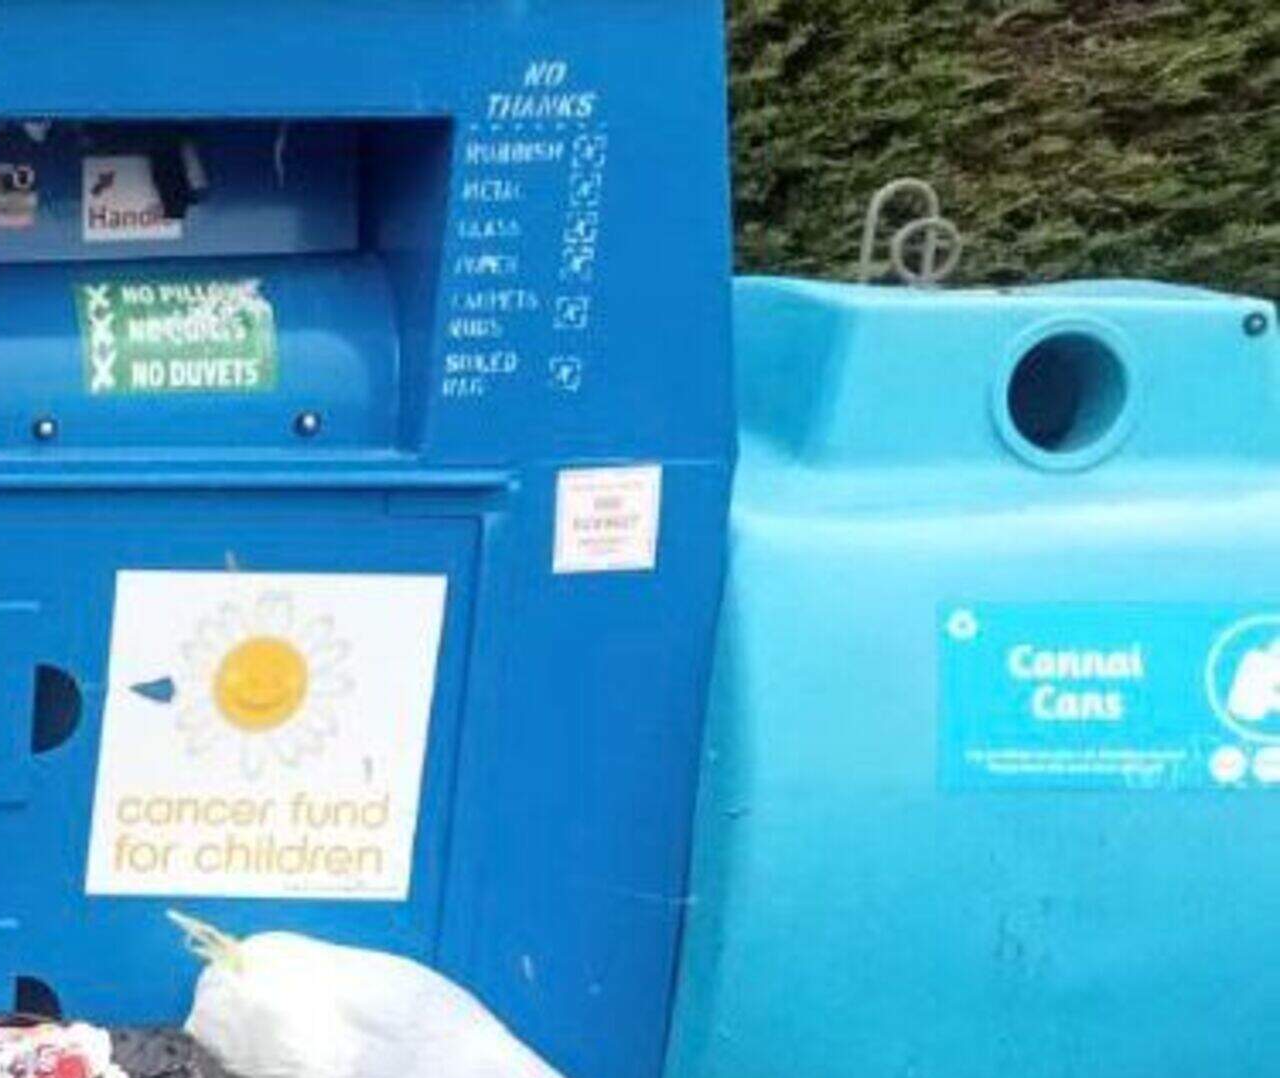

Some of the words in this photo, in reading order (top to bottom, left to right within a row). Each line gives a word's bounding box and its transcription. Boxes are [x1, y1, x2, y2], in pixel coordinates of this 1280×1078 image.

[525, 61, 567, 86] NO
[488, 92, 597, 119] THANKS
[121, 286, 156, 304] NO
[132, 361, 165, 387] NO
[169, 358, 259, 387] DUVETS
[1031, 685, 1125, 722] Cans
[116, 796, 274, 826] cancer
[292, 791, 390, 829] fund
[113, 834, 176, 874] for
[194, 834, 384, 875] children
